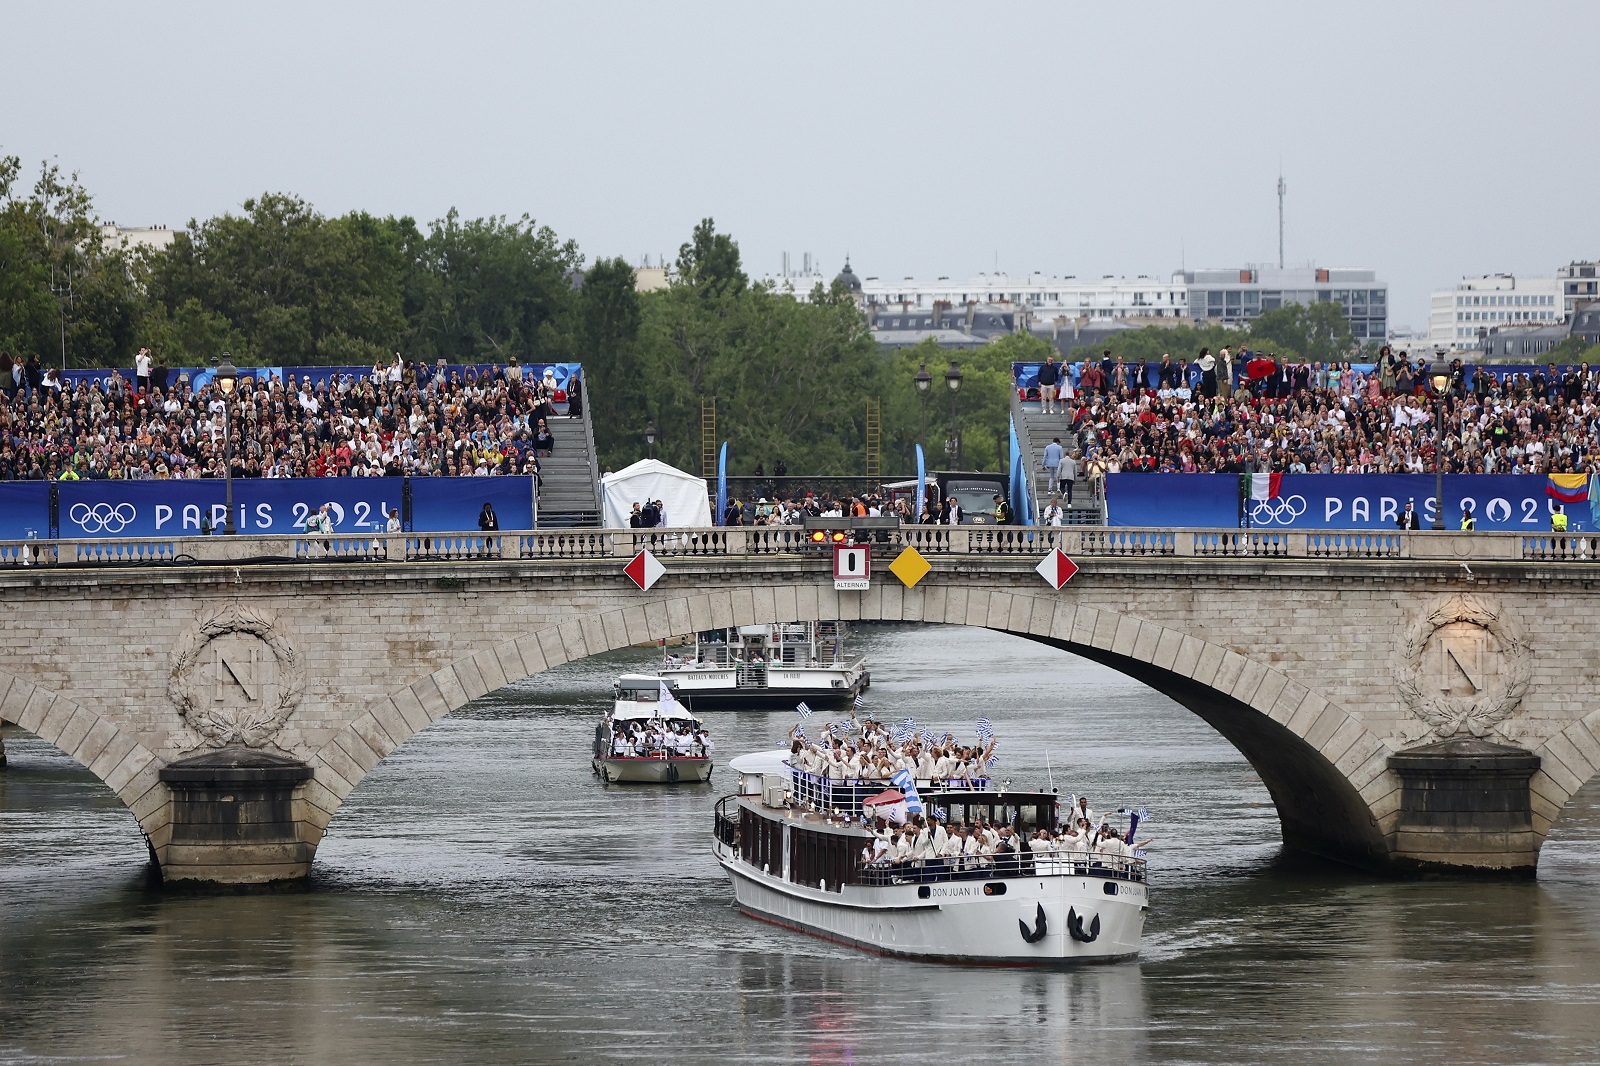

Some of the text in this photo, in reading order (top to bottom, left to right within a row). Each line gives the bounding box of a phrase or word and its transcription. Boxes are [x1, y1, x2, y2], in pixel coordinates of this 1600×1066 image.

[214, 646, 259, 701] N
[1440, 637, 1484, 691] N
[932, 888, 948, 897] DON
[948, 887, 971, 896] JUAN
